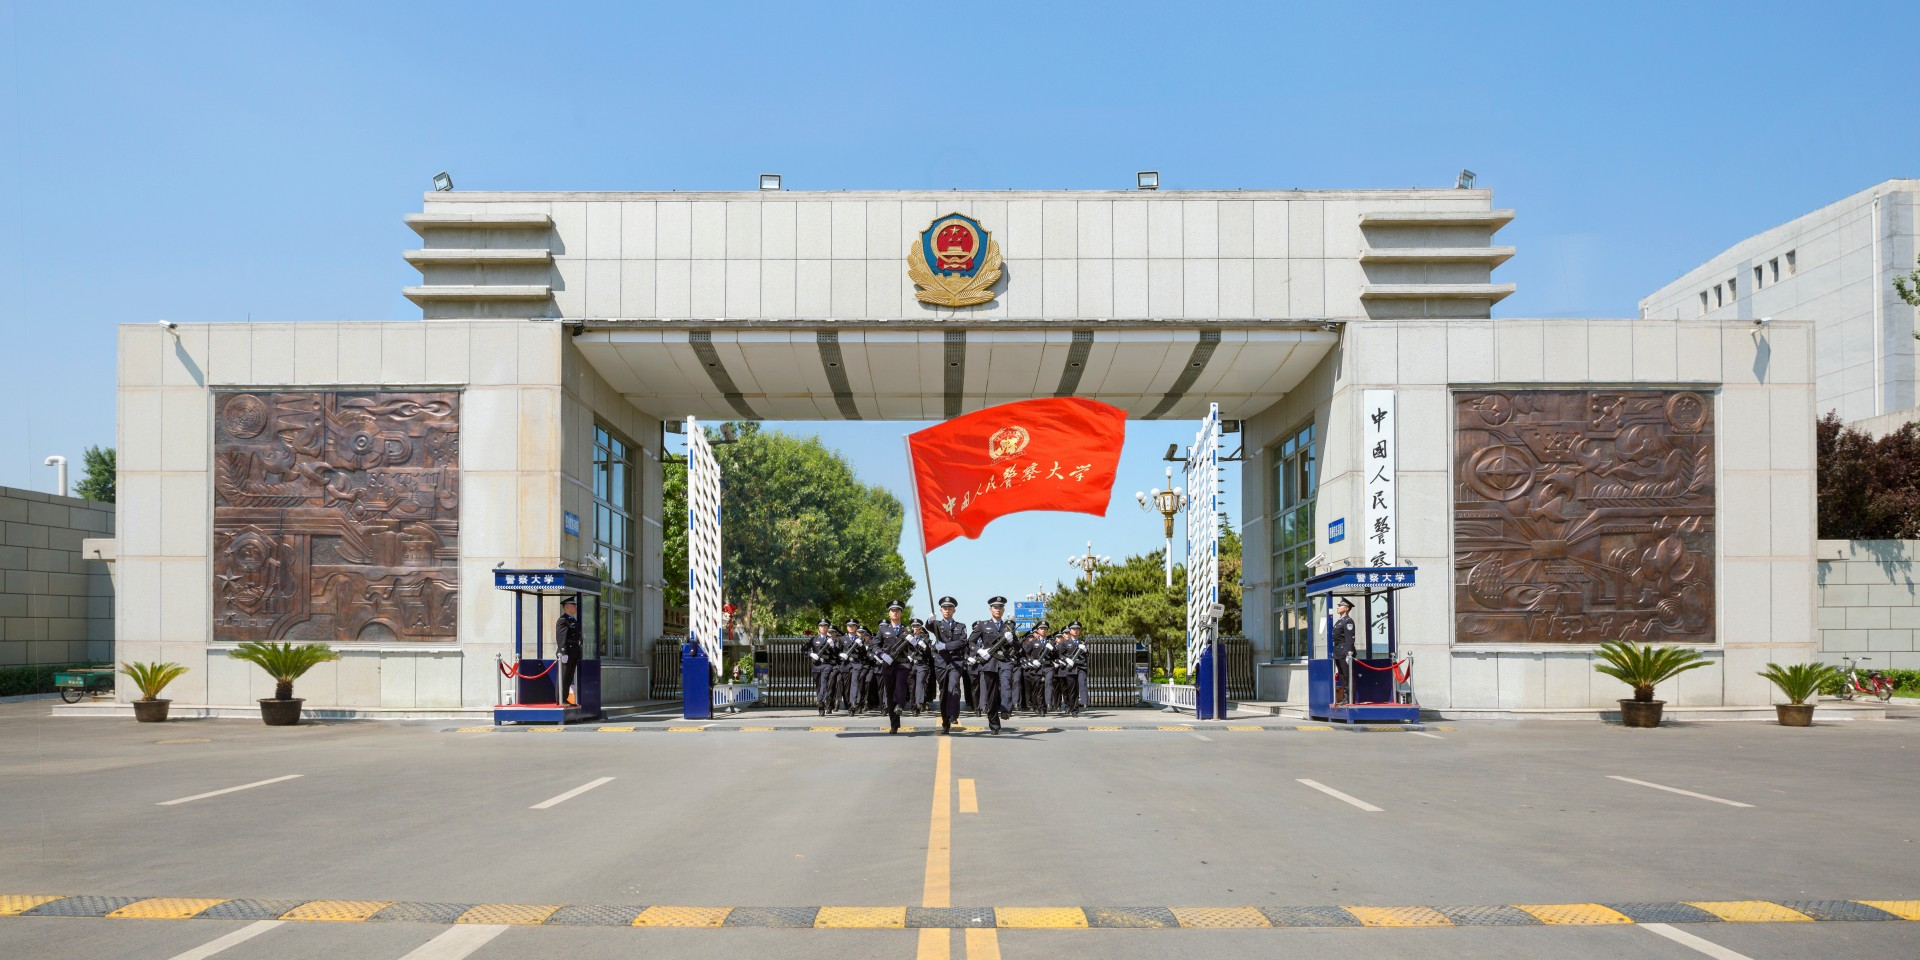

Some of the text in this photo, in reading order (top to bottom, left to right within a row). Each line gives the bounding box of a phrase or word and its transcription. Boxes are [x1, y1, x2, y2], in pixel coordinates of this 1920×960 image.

[505, 575, 554, 584] 警察大学
[1356, 573, 1405, 582] 警察大学
